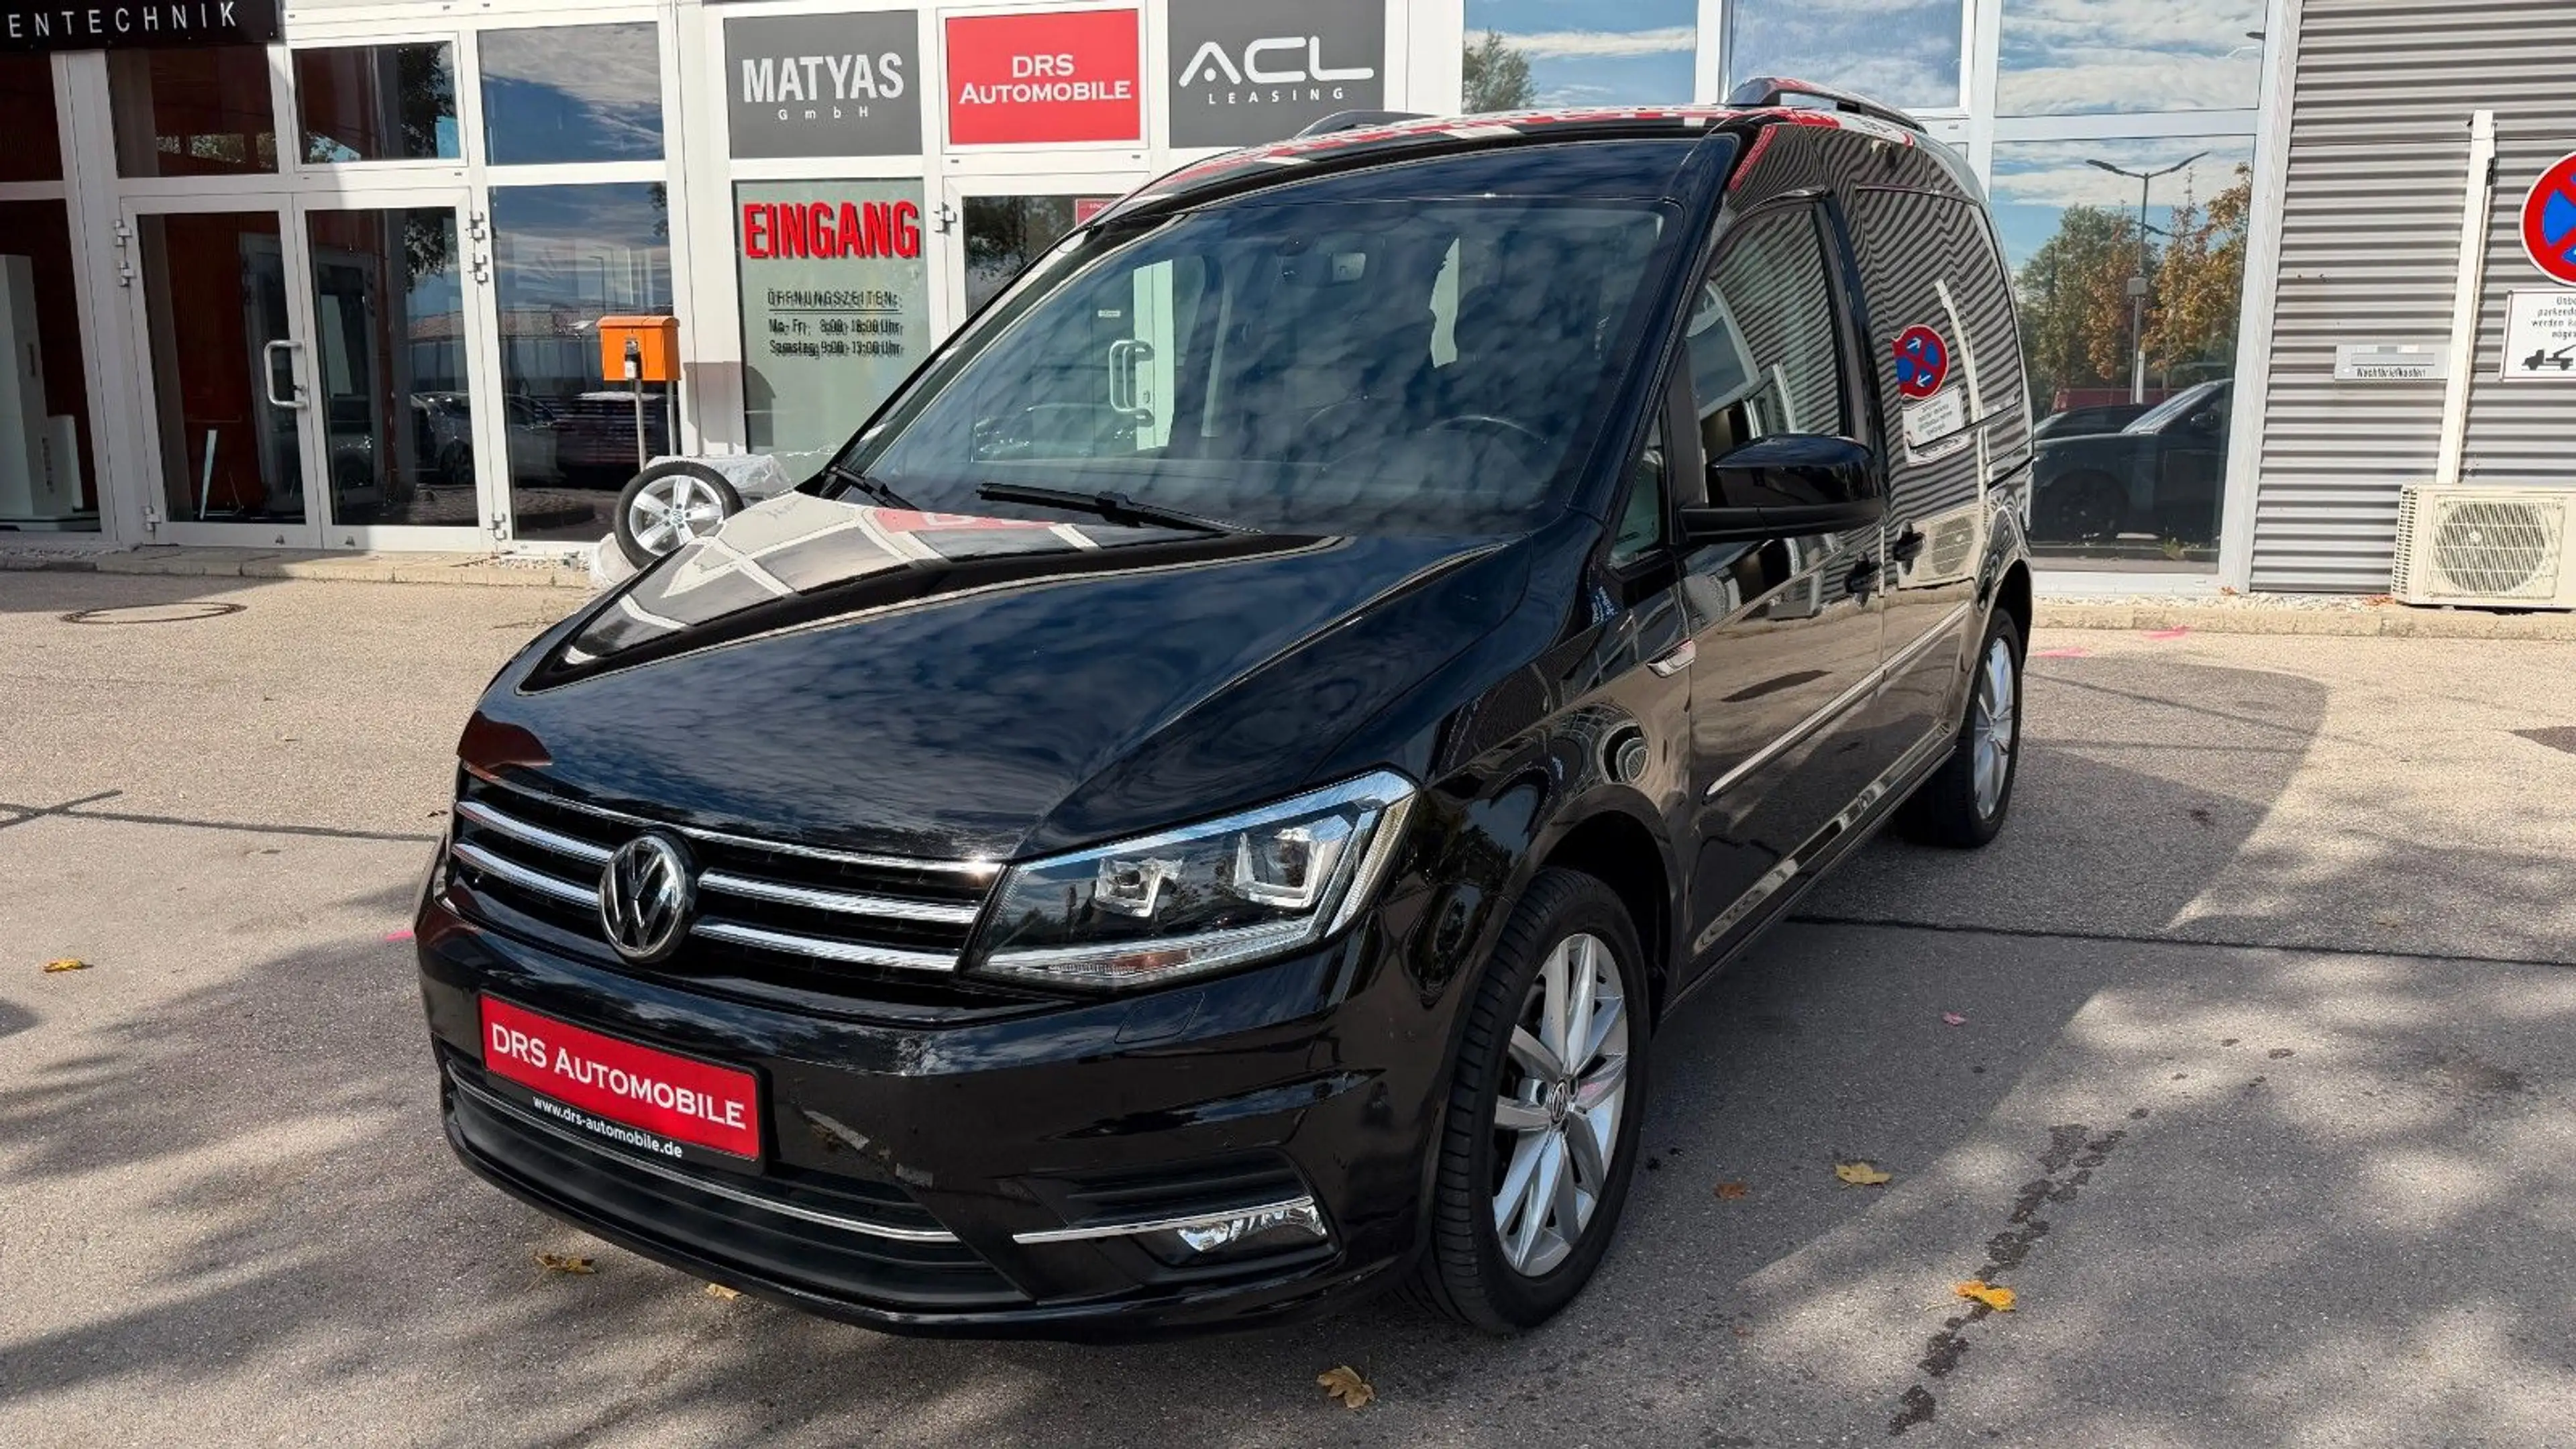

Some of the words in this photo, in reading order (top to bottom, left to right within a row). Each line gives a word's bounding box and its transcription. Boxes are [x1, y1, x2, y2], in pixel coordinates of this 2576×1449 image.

[8, 1, 236, 38] ENTECHNIK
[1012, 54, 1075, 78] DRS
[1179, 36, 1374, 87] ACL
[742, 52, 904, 103] MATYAS
[959, 80, 1132, 104] AUTOMOBILE
[1209, 87, 1343, 104] LEASING
[778, 105, 868, 120] GmbH
[744, 201, 920, 259] EINGANG
[881, 318, 901, 333] Uhr
[881, 340, 901, 355] Uhr
[491, 1022, 547, 1069] DRS
[554, 1046, 747, 1130] AUTOMOBILE
[533, 1096, 683, 1159] www.drs-automobile.de
